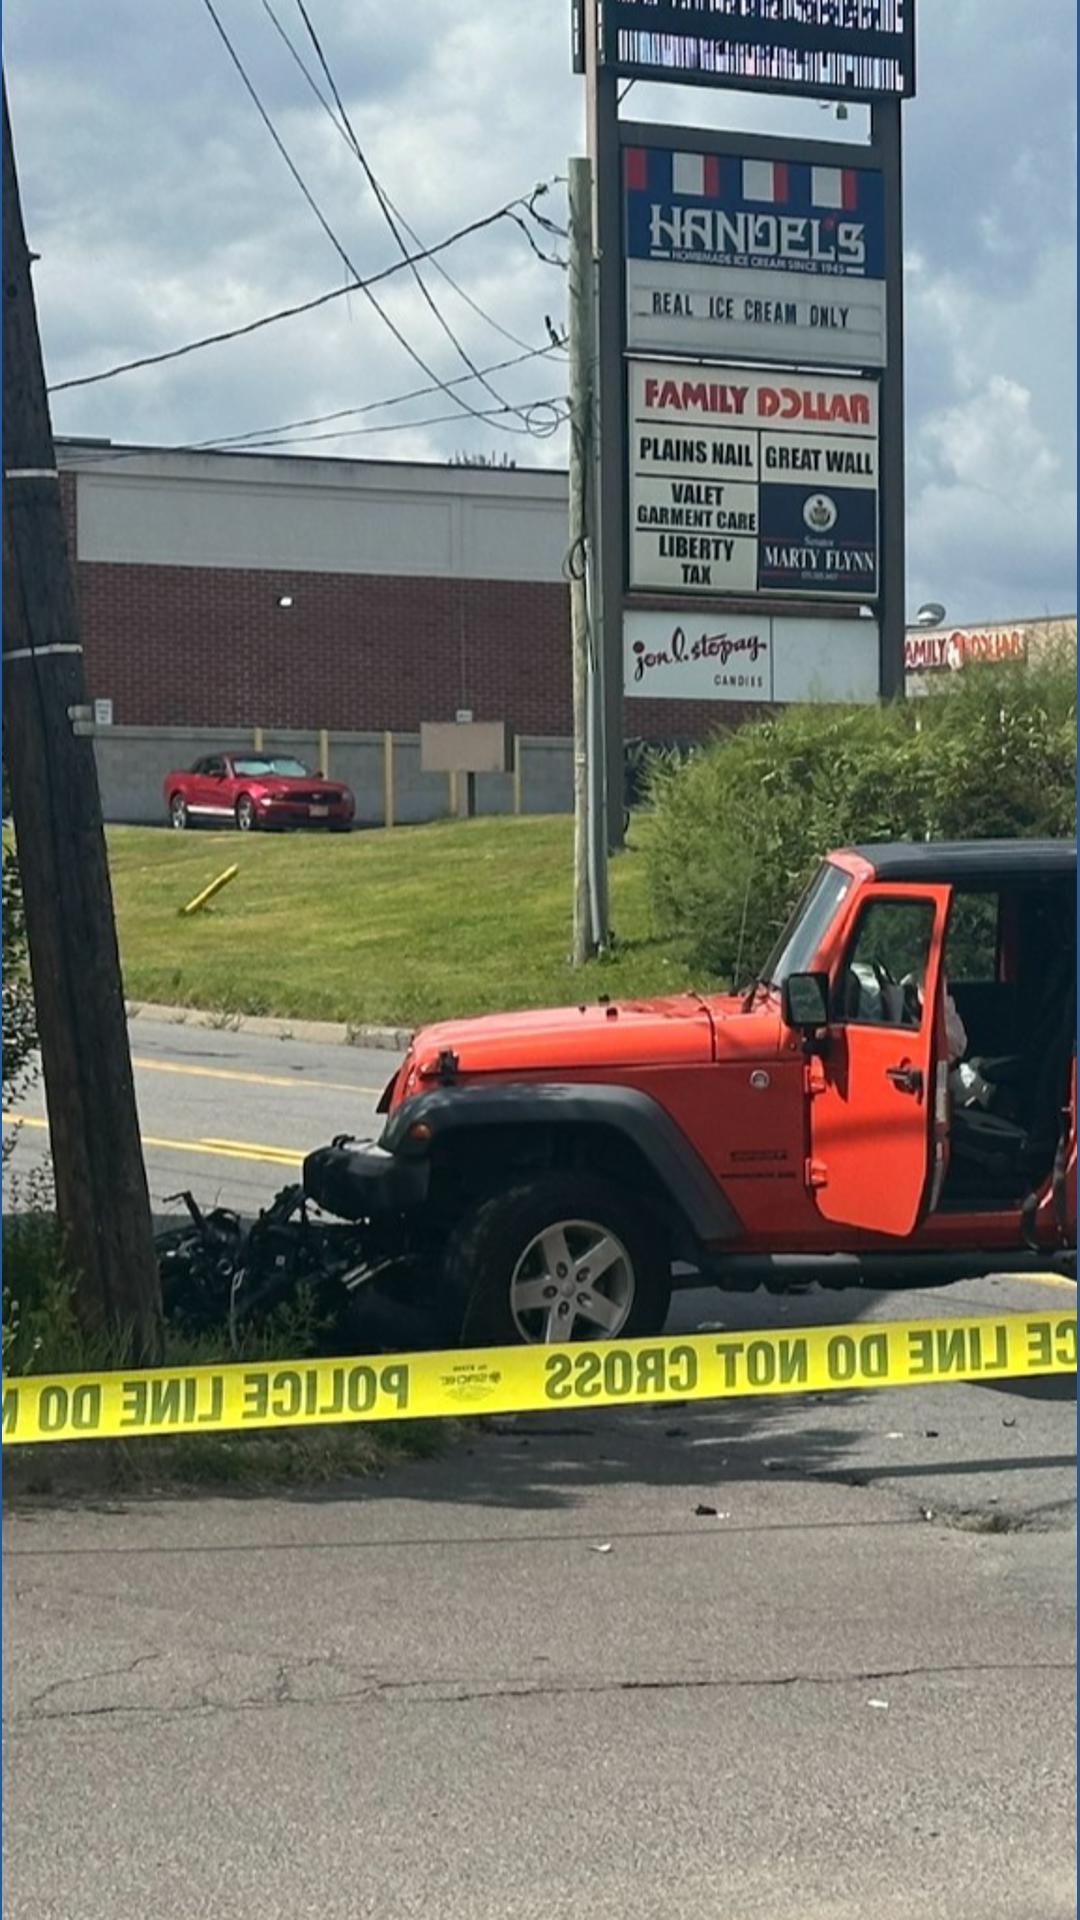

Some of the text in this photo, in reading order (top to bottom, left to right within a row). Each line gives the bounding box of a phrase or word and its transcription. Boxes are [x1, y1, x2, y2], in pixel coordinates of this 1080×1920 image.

[649, 203, 866, 264] HANDEL'S
[672, 250, 845, 275] HOMEMADE ICE CREAM SINCE 1945
[653, 291, 850, 329] REAL ICE CREAM ONLY
[644, 378, 870, 424] FAMILY DOLLAR
[639, 436, 754, 467] PLAINS NAIL
[765, 445, 874, 475] GREAT WALL
[671, 482, 724, 506] VALET
[637, 505, 756, 531] GARMENT CARE
[658, 534, 735, 561] LIBERTY
[764, 545, 874, 572] MARTY FLYNN
[681, 563, 711, 585] TAX
[904, 636, 948, 667] AMILY
[713, 674, 763, 687] CANDIES
